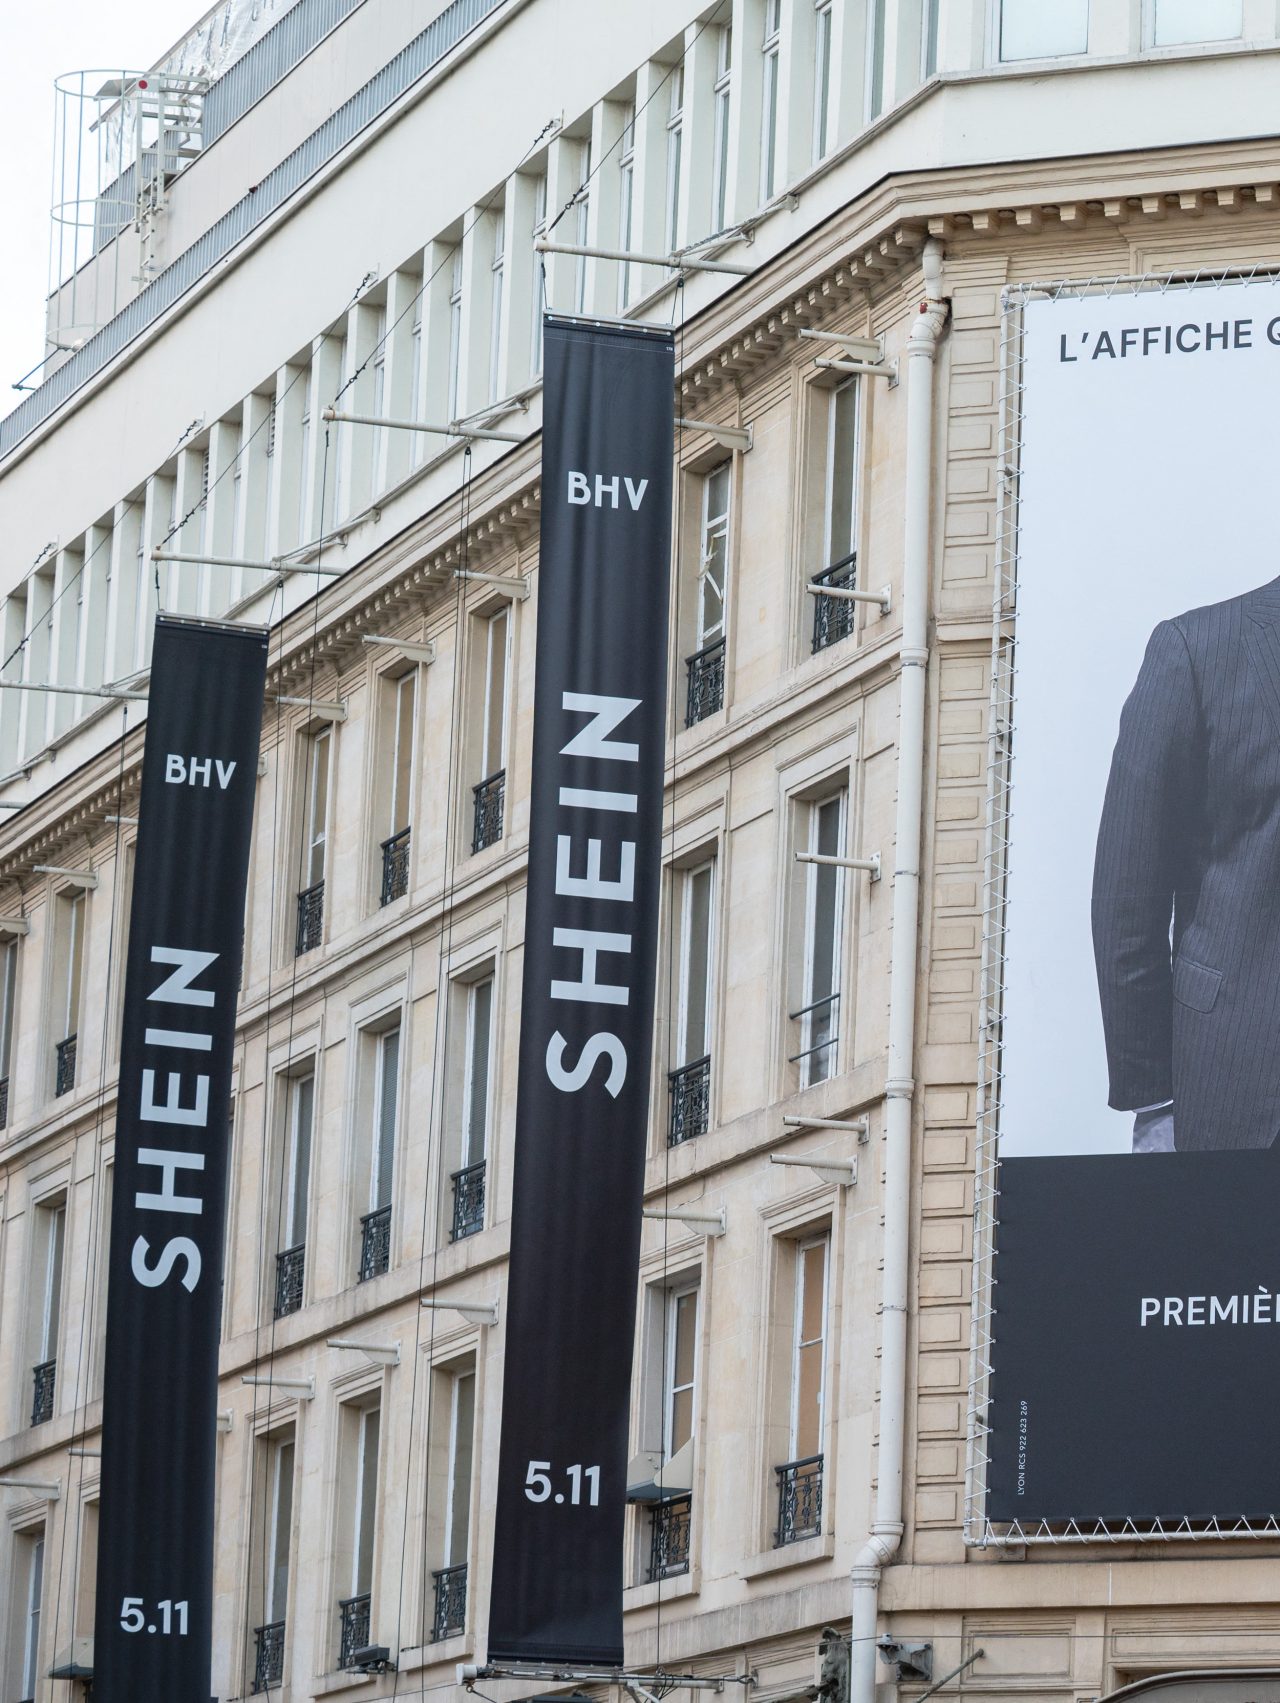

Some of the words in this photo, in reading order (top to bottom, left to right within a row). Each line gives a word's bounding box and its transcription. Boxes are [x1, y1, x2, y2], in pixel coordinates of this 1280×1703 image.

[1060, 321, 1253, 363] L’AFFICHE
[567, 470, 649, 511] BHV
[164, 753, 237, 790] BHV
[545, 691, 643, 1099] SHEIN
[131, 945, 220, 1293] SHEIN
[1019, 1417, 1028, 1434] 623
[1020, 1400, 1028, 1416] 269
[1018, 1435, 1027, 1451] 922
[1018, 1452, 1026, 1470] RCS
[524, 1460, 601, 1507] 5.11
[1017, 1472, 1025, 1496] LYON
[120, 1597, 189, 1635] 5.11
